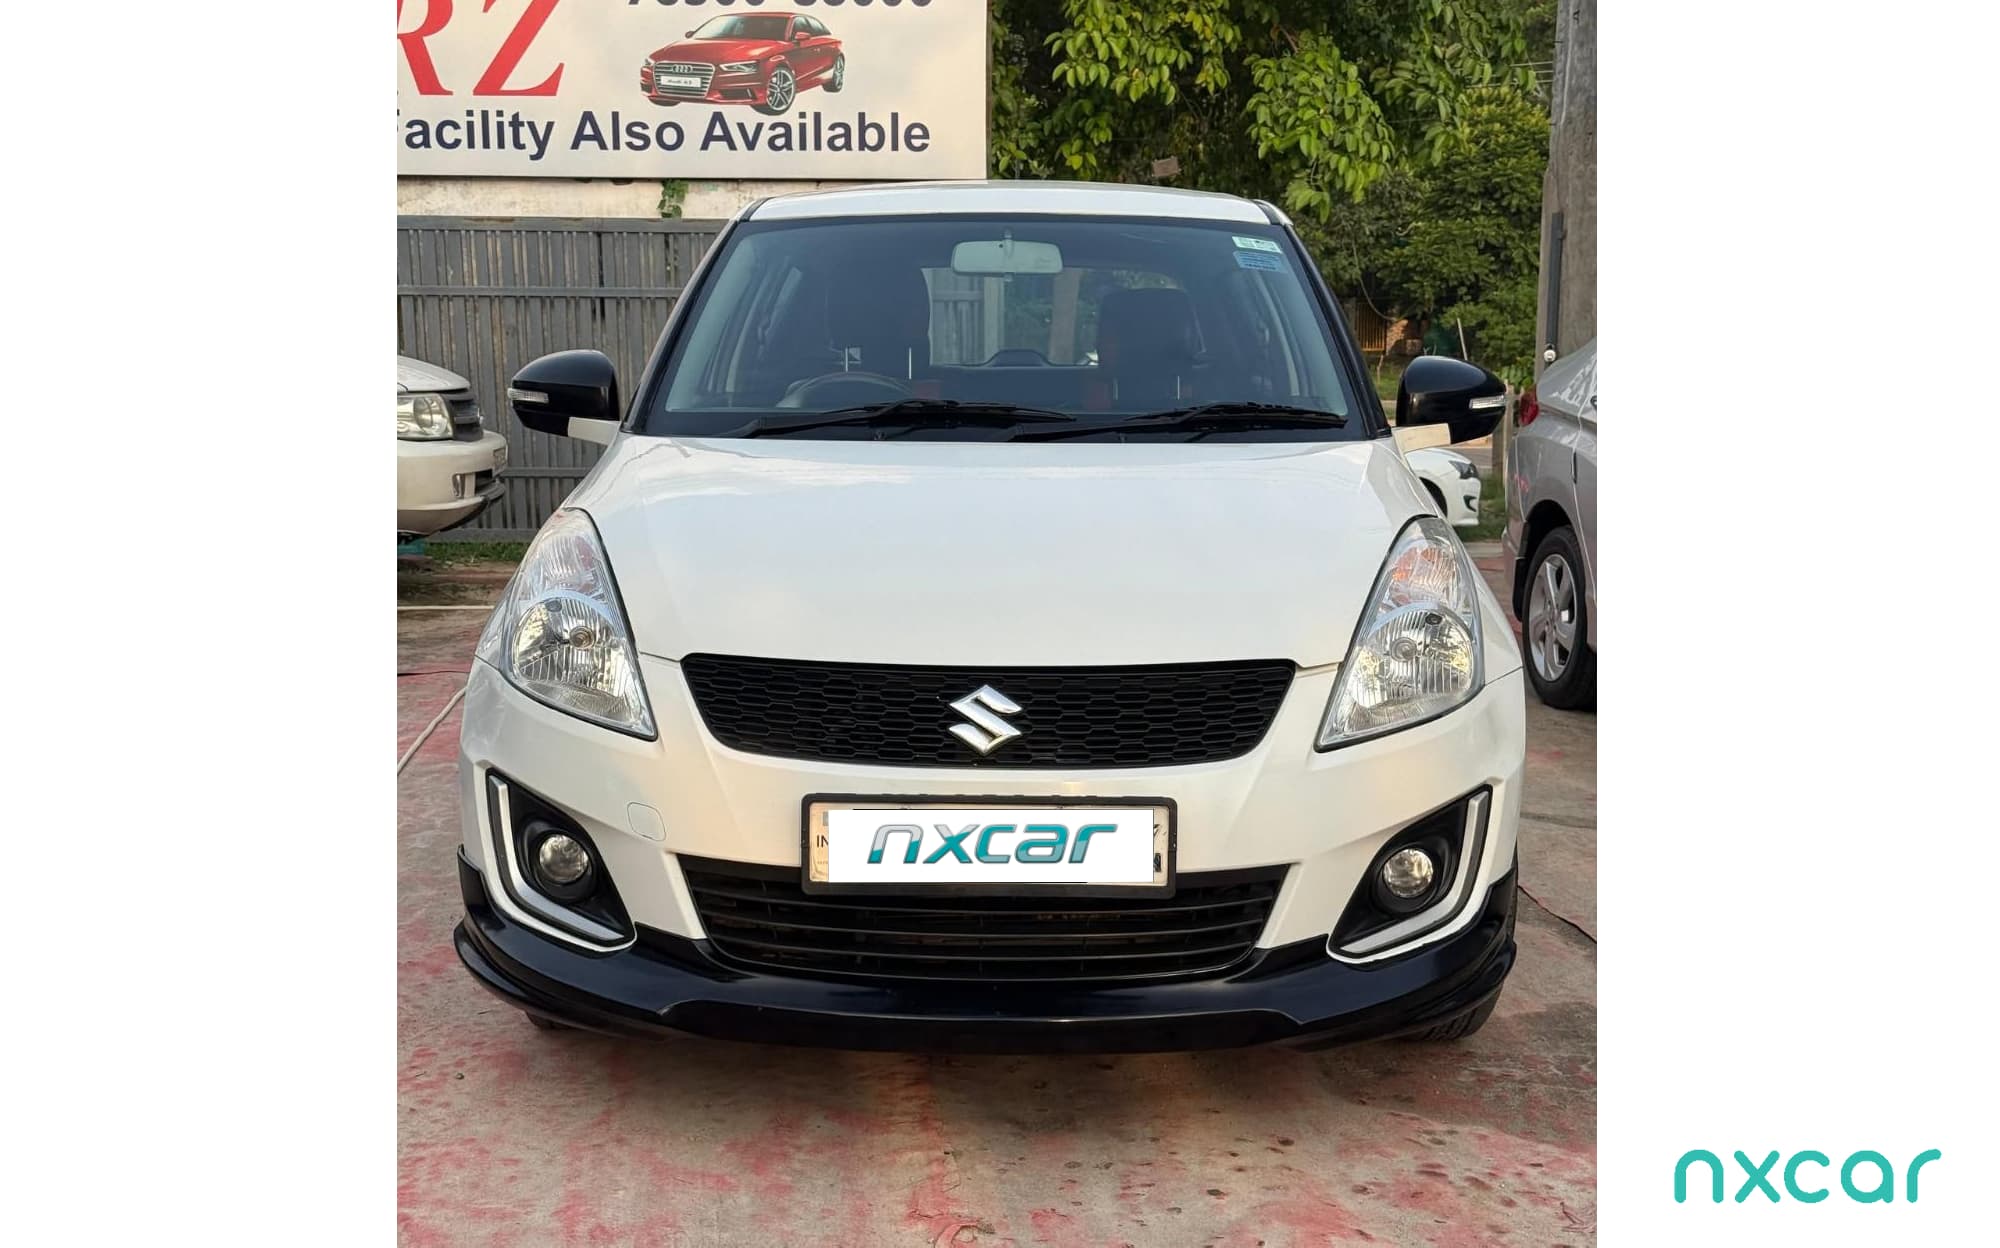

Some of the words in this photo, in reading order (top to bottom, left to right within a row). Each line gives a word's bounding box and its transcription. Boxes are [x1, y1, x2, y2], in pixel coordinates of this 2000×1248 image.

[397, 109, 555, 161] acility
[570, 110, 685, 152] Also
[699, 111, 930, 153] Available
